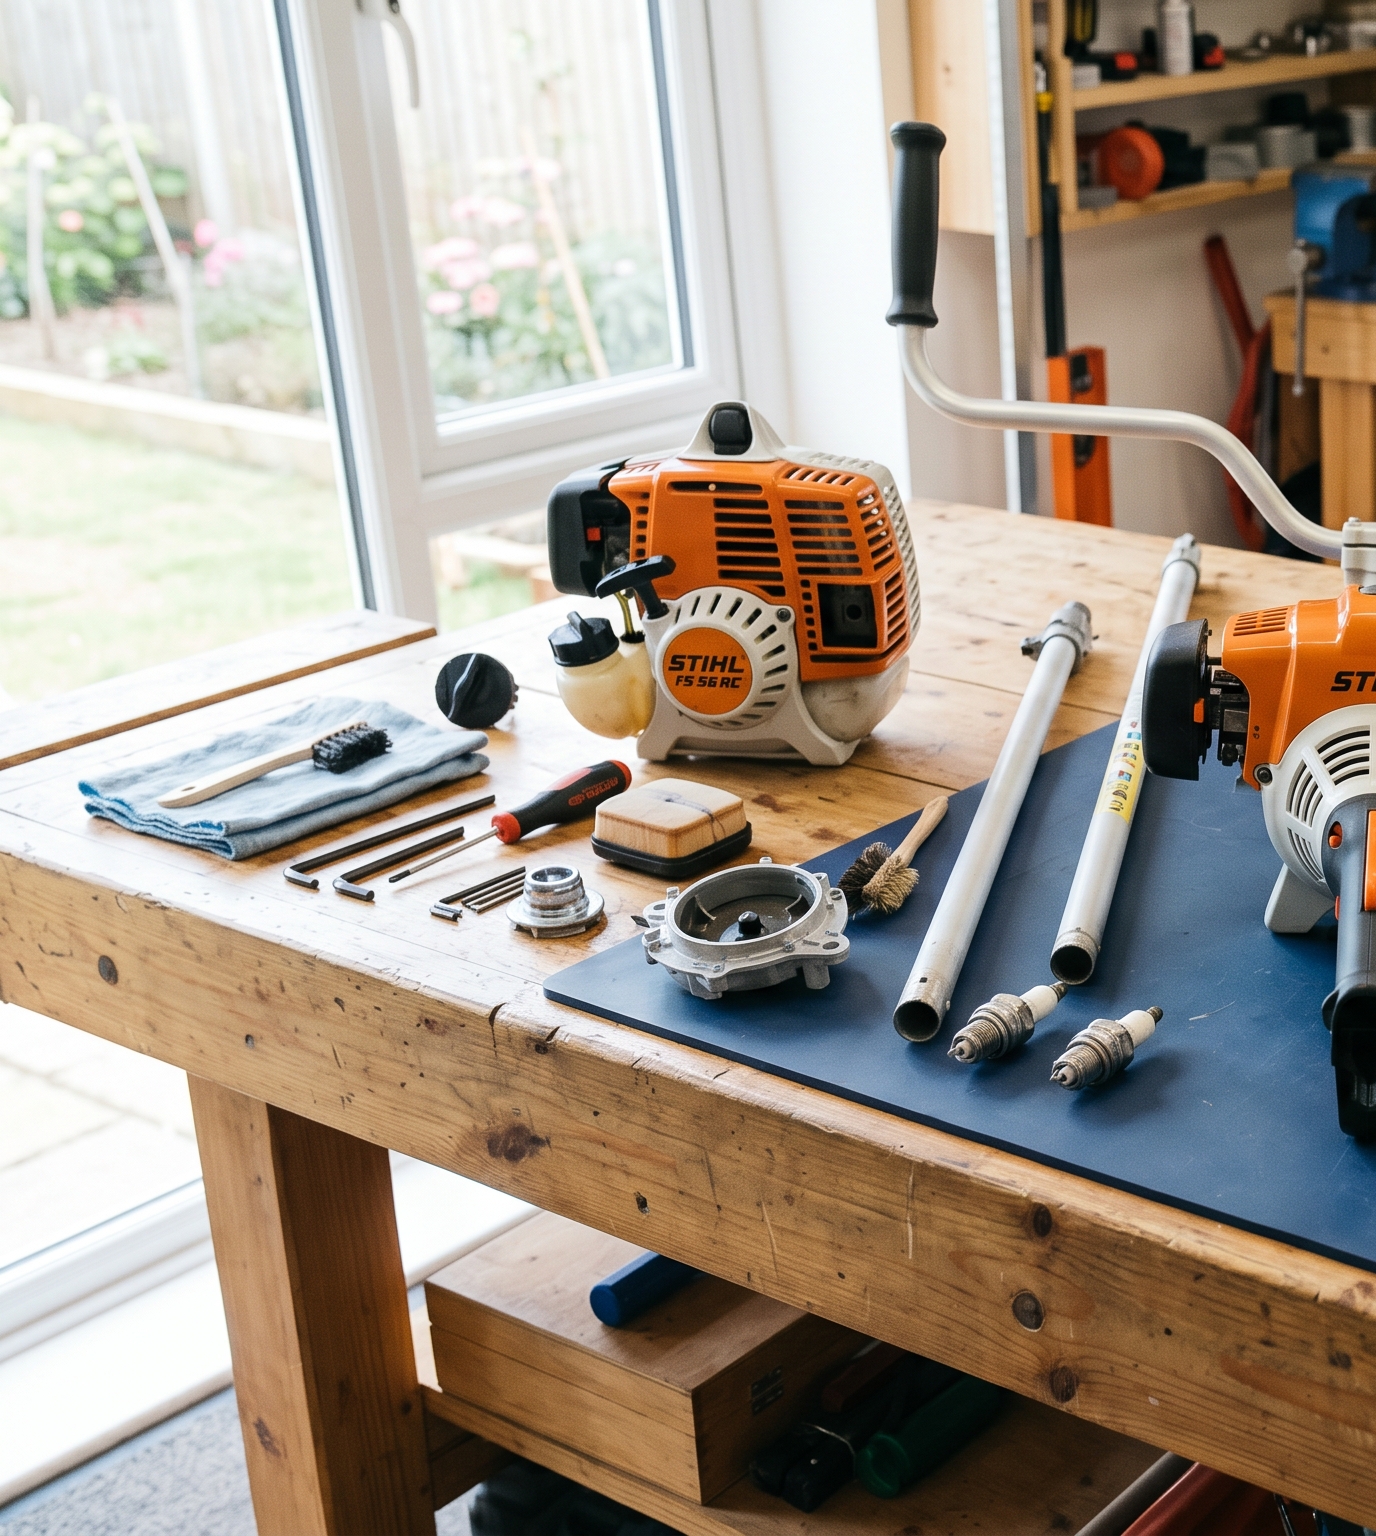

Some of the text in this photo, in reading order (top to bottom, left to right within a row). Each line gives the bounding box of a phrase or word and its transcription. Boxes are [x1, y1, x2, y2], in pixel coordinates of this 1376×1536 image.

[668, 654, 744, 673] STIHL
[696, 676, 718, 688] 56
[719, 676, 742, 688] RC
